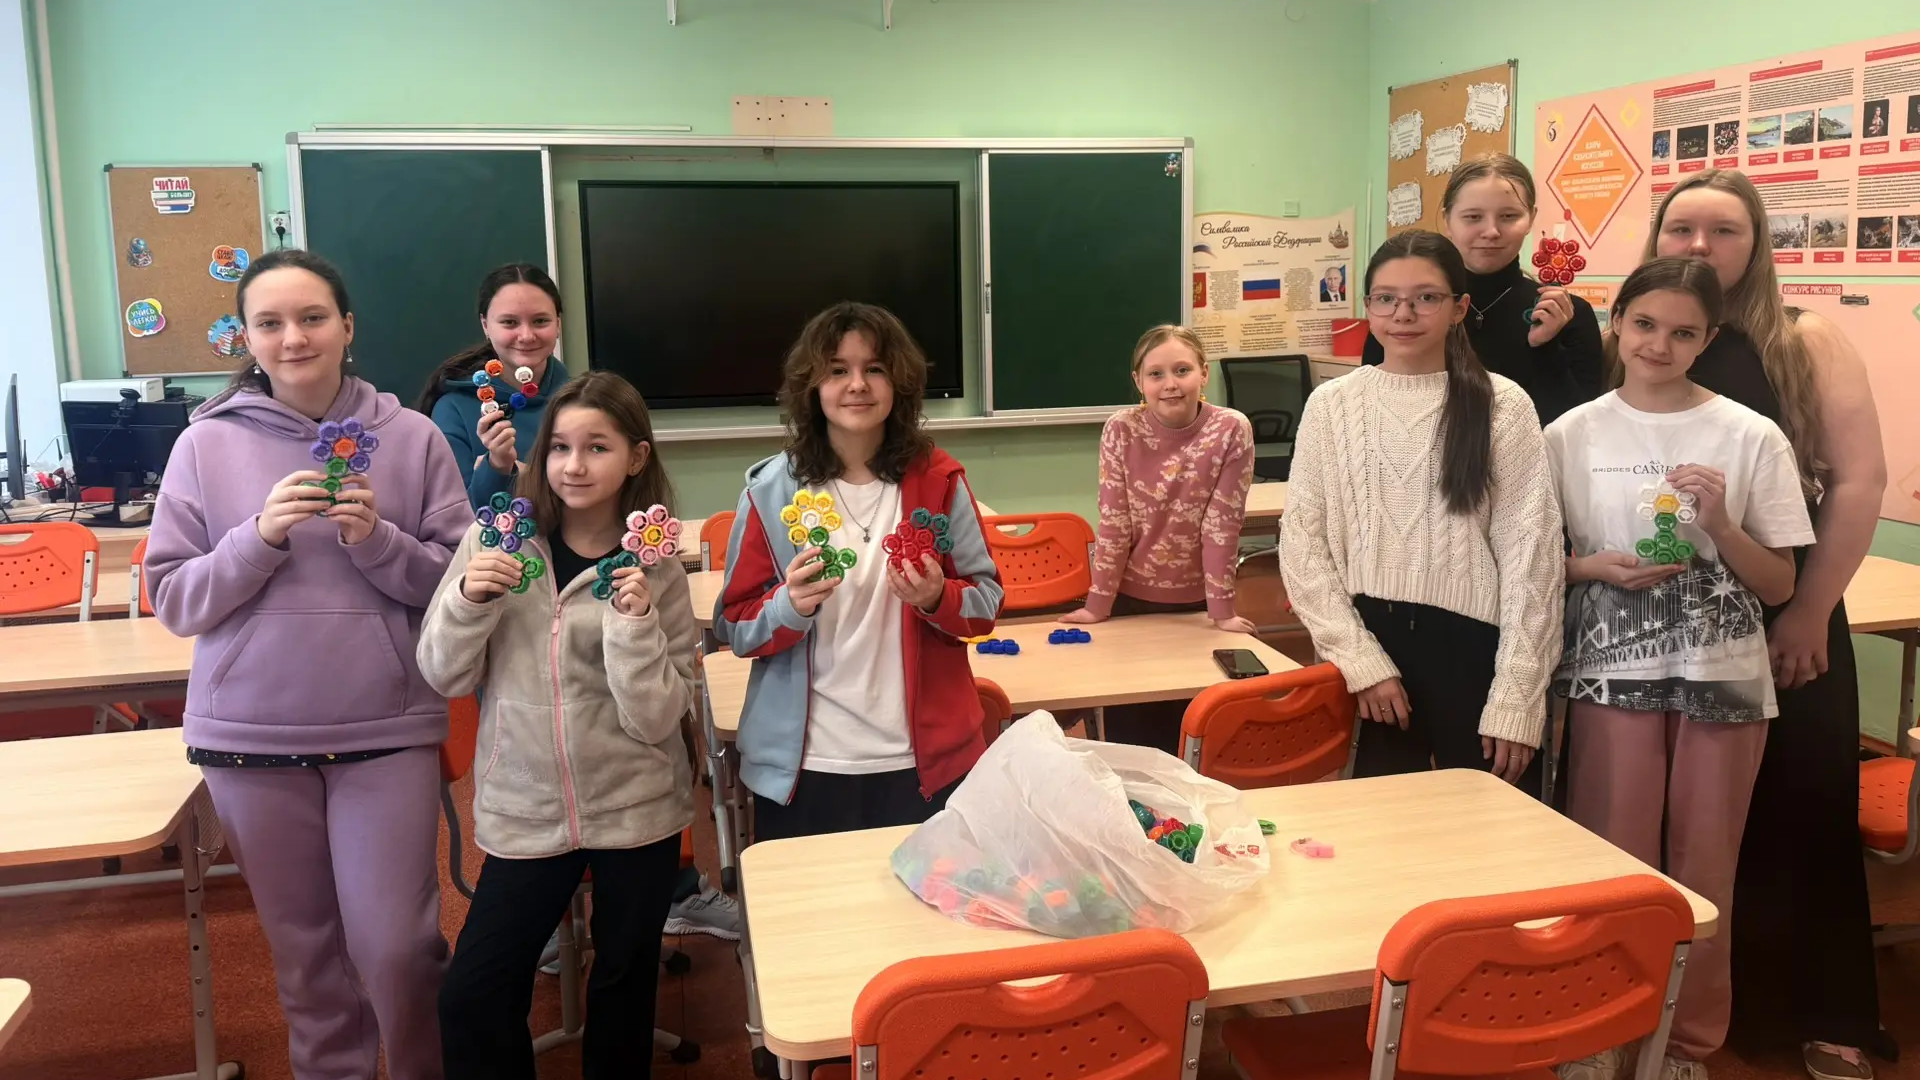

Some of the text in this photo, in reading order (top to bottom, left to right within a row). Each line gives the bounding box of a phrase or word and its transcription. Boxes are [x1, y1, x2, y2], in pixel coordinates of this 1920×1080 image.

[155, 178, 188, 190] ЧИТАЙ
[1200, 220, 1250, 236] Символика
[1222, 231, 1322, 249] Российской Федерации
[1783, 285, 1841, 294] КОНКУРС РИСУНКОВ
[131, 308, 155, 317] УЧИСЬ
